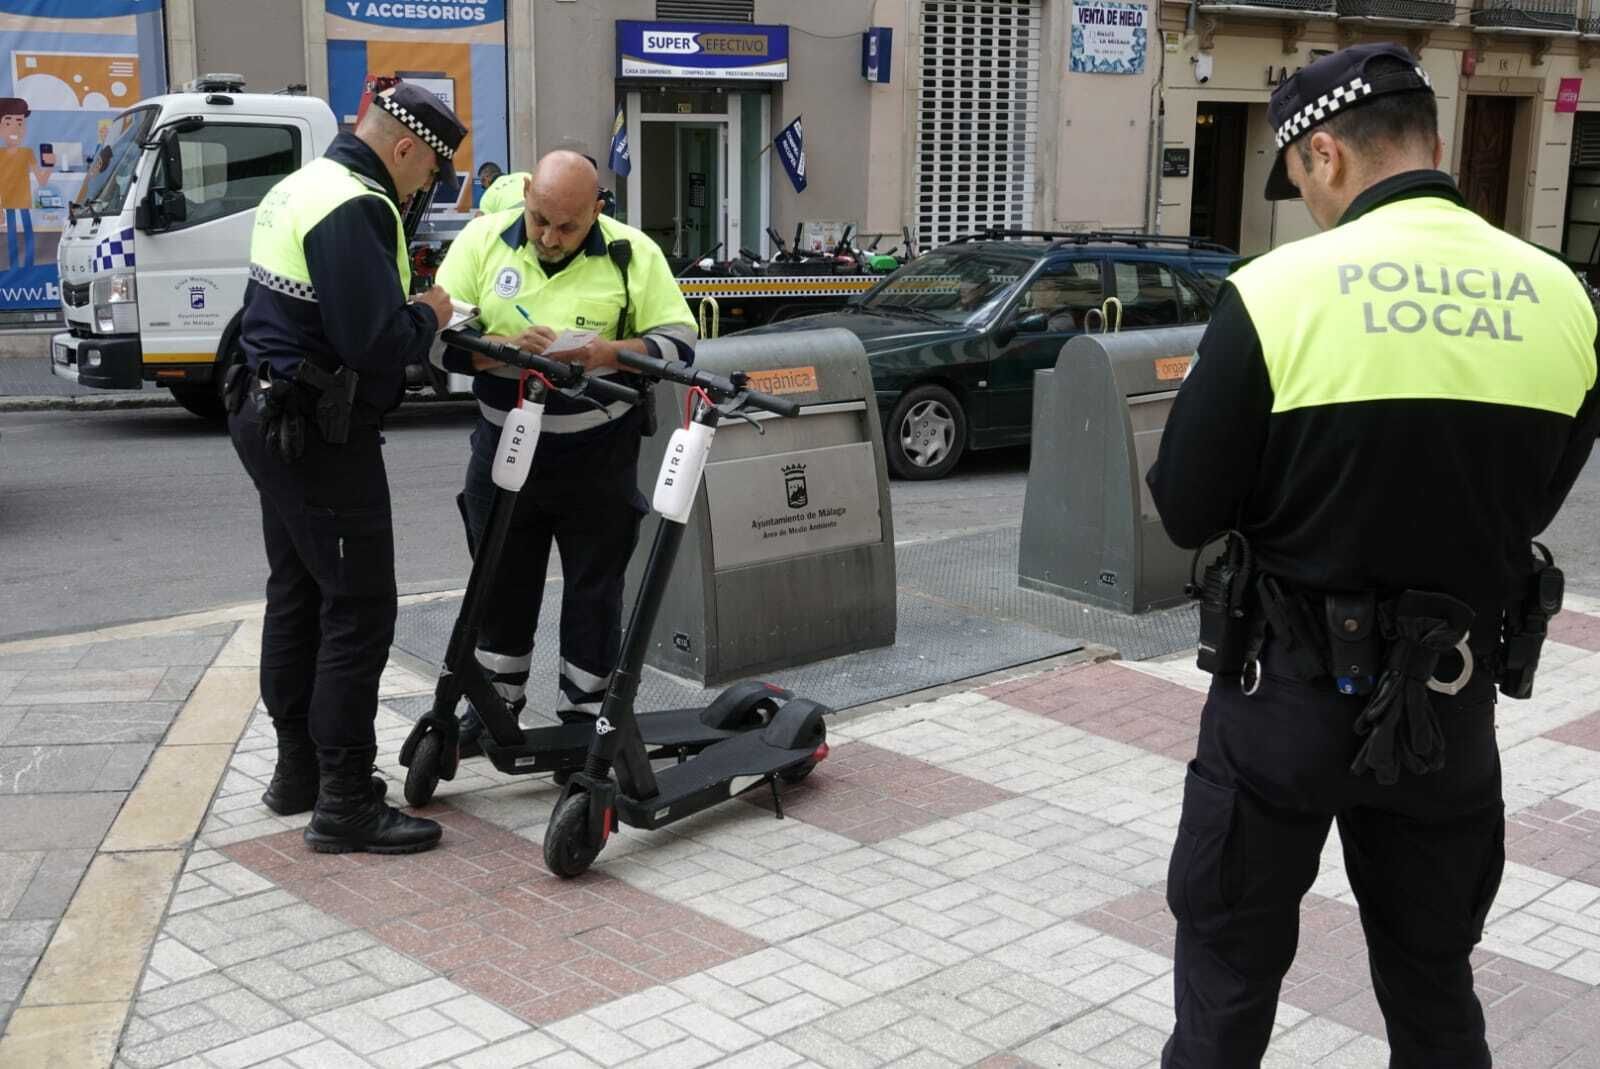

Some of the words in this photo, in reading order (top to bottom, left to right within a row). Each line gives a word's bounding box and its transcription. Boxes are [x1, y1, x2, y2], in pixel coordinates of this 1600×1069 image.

[347, 2, 359, 16] Y
[366, 3, 486, 20] ACCESORIOS
[1079, 8, 1105, 25] VENTA
[1107, 9, 1118, 26] DE
[1120, 11, 1143, 26] HIELO
[648, 36, 691, 49] SUPER
[706, 38, 764, 51] EFECTIVO
[1338, 262, 1540, 304] POLICIA
[1363, 300, 1524, 342] LOCAL
[507, 424, 525, 464] BIRD
[664, 443, 684, 487] BIRD
[752, 513, 805, 530] Ayuntamiento
[807, 511, 816, 520] de
[818, 507, 846, 517] Málaga
[788, 526, 808, 535] Medio
